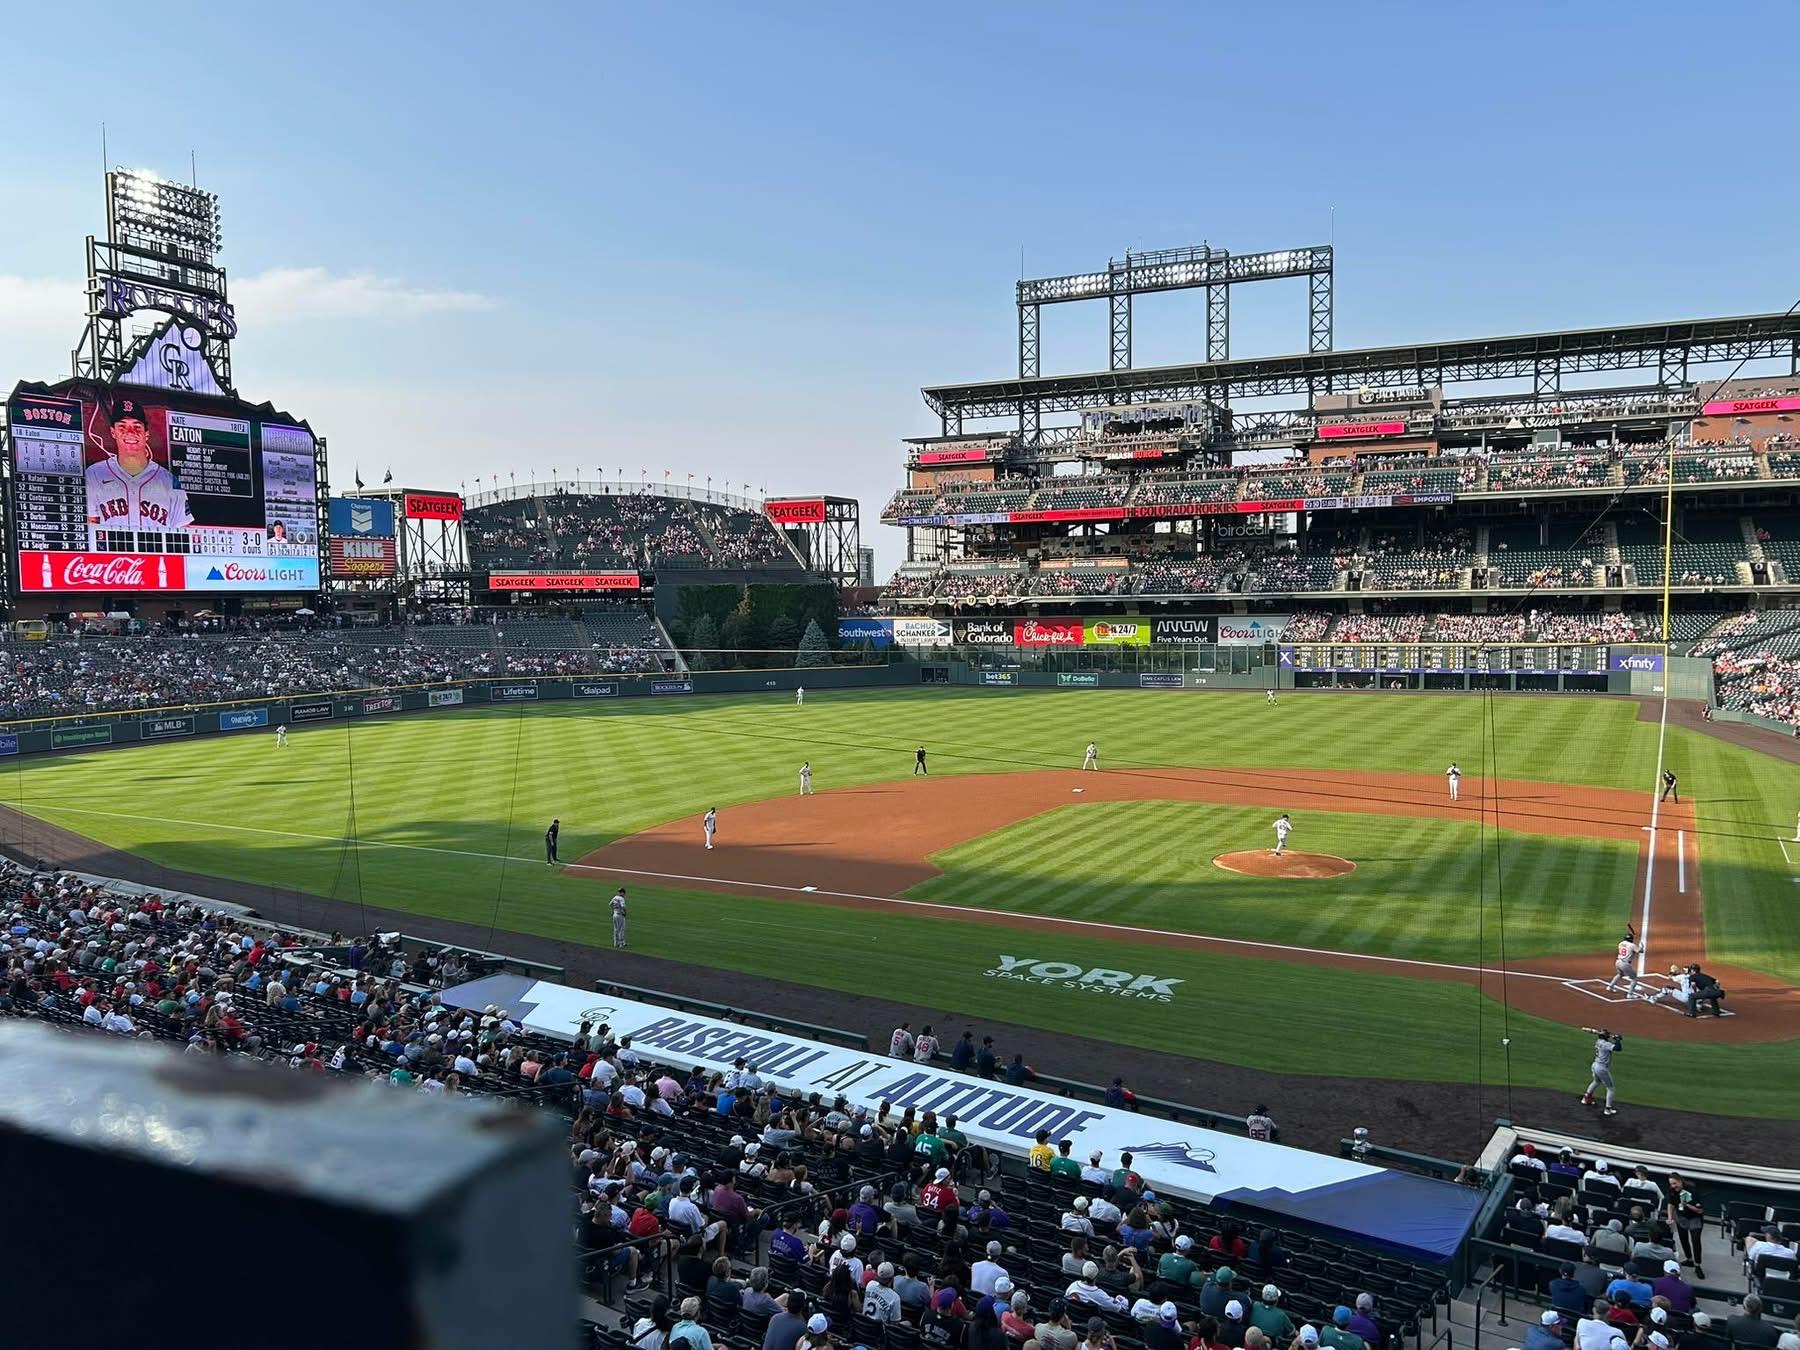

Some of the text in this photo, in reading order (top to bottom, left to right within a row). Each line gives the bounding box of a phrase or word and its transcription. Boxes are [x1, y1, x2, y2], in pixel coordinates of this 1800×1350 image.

[1376, 389, 1394, 399] JACK
[1733, 401, 1779, 411] SEATGEEK
[23, 408, 71, 425] BOSTON
[172, 416, 186, 425] NATE
[1525, 416, 1560, 428] Silver
[25, 429, 40, 437] Eaton
[172, 427, 202, 443] EATON
[1343, 425, 1379, 434] SEATGEEK
[1260, 501, 1296, 509] SEATGEEK
[1413, 495, 1451, 503] EMPOWER
[100, 500, 169, 526] RED SOX
[410, 499, 458, 515] SEATGEEK
[767, 504, 819, 519] SEATGEEK
[1122, 507, 1137, 517] THE
[1139, 505, 1194, 517] COLORADO
[1195, 502, 1238, 513] ROCKIES
[343, 543, 383, 559] KING
[64, 556, 145, 586] Coca-Cola
[224, 562, 304, 581] Coors LIGHT
[344, 559, 385, 575] Soopers
[496, 578, 633, 587] SEATGEEK SEATGEEK SEATGEEK
[838, 627, 885, 638] Southwest
[905, 622, 936, 630] BACHUS
[968, 622, 1004, 632] Bank of
[1118, 624, 1137, 635] 24/7
[1220, 626, 1283, 639] Coors LIGH
[896, 629, 936, 637] SCHANKER
[968, 632, 1013, 643] Colorado
[1619, 657, 1656, 670] xfinity
[503, 684, 535, 696] Lifetime
[584, 684, 611, 697] dialpad
[997, 954, 1186, 995] YORK
[983, 969, 1172, 1002] SPACE SYSTEMS
[894, 1036, 901, 1046] 5
[917, 1041, 929, 1053] 48
[620, 1016, 1106, 1145] BASEBALL AT ALTITUDE
[915, 1140, 932, 1156] 45
[1029, 1154, 1042, 1168] 16
[923, 1193, 940, 1208] 34
[865, 1302, 877, 1316] 2
